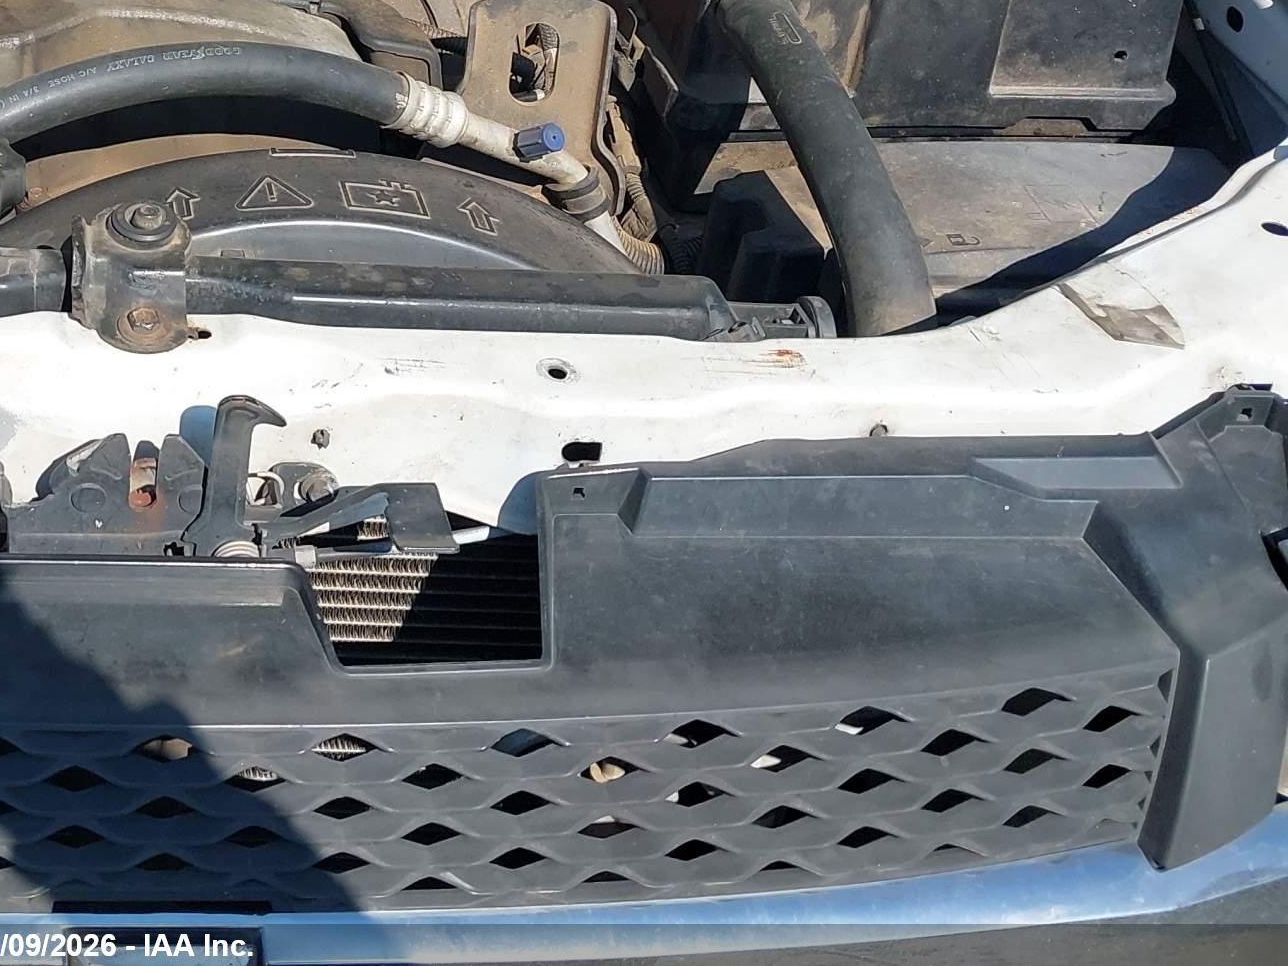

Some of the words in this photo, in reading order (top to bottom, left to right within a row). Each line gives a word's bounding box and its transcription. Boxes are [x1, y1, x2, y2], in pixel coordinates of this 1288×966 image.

[161, 45, 242, 61] GOODYEAR
[105, 54, 155, 72] GALAXY
[77, 66, 98, 78] A/C
[46, 73, 76, 88] HOSE
